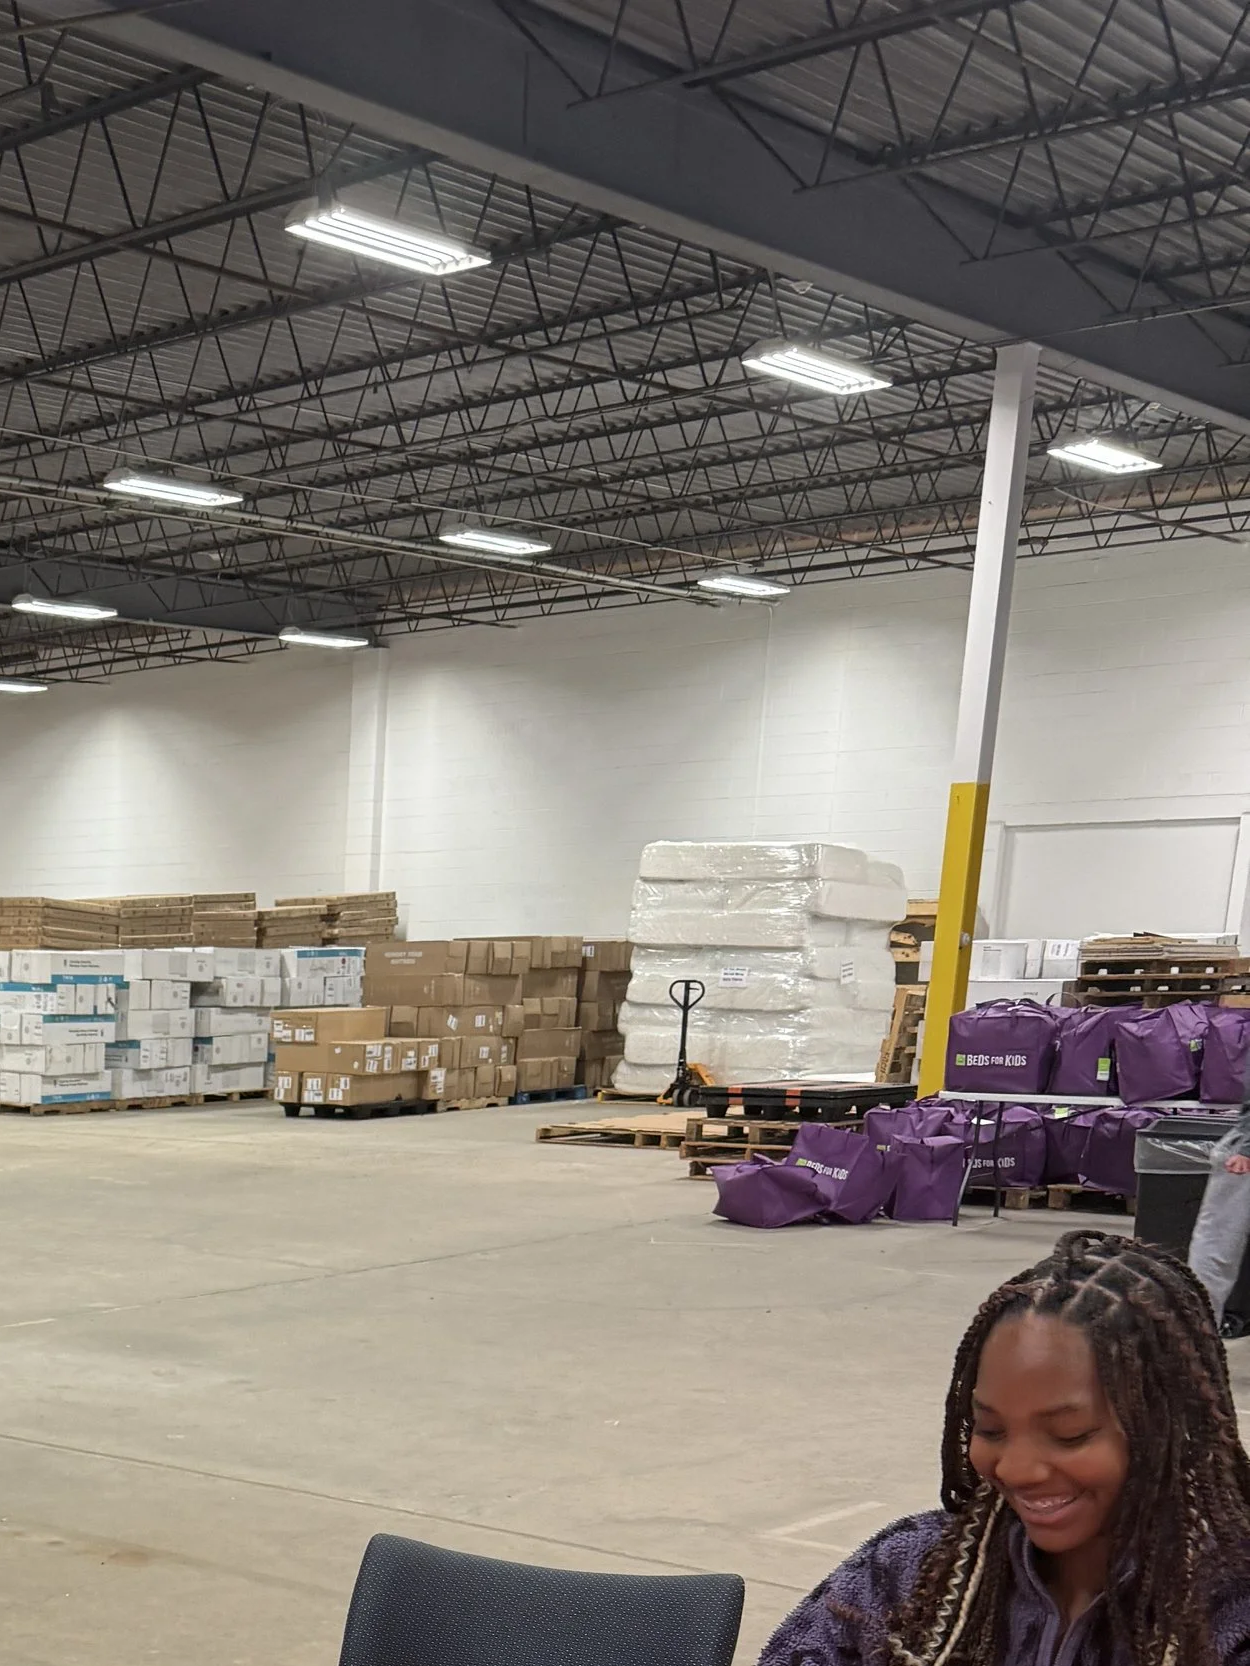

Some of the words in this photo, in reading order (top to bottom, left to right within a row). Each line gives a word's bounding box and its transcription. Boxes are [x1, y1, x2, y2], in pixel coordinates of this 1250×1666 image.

[966, 1054, 990, 1067] BEDS
[990, 1056, 1004, 1065] FOR
[1004, 1054, 1027, 1067] KIDS
[982, 1159, 994, 1168] FOR
[832, 1167, 849, 1180] KIDS
